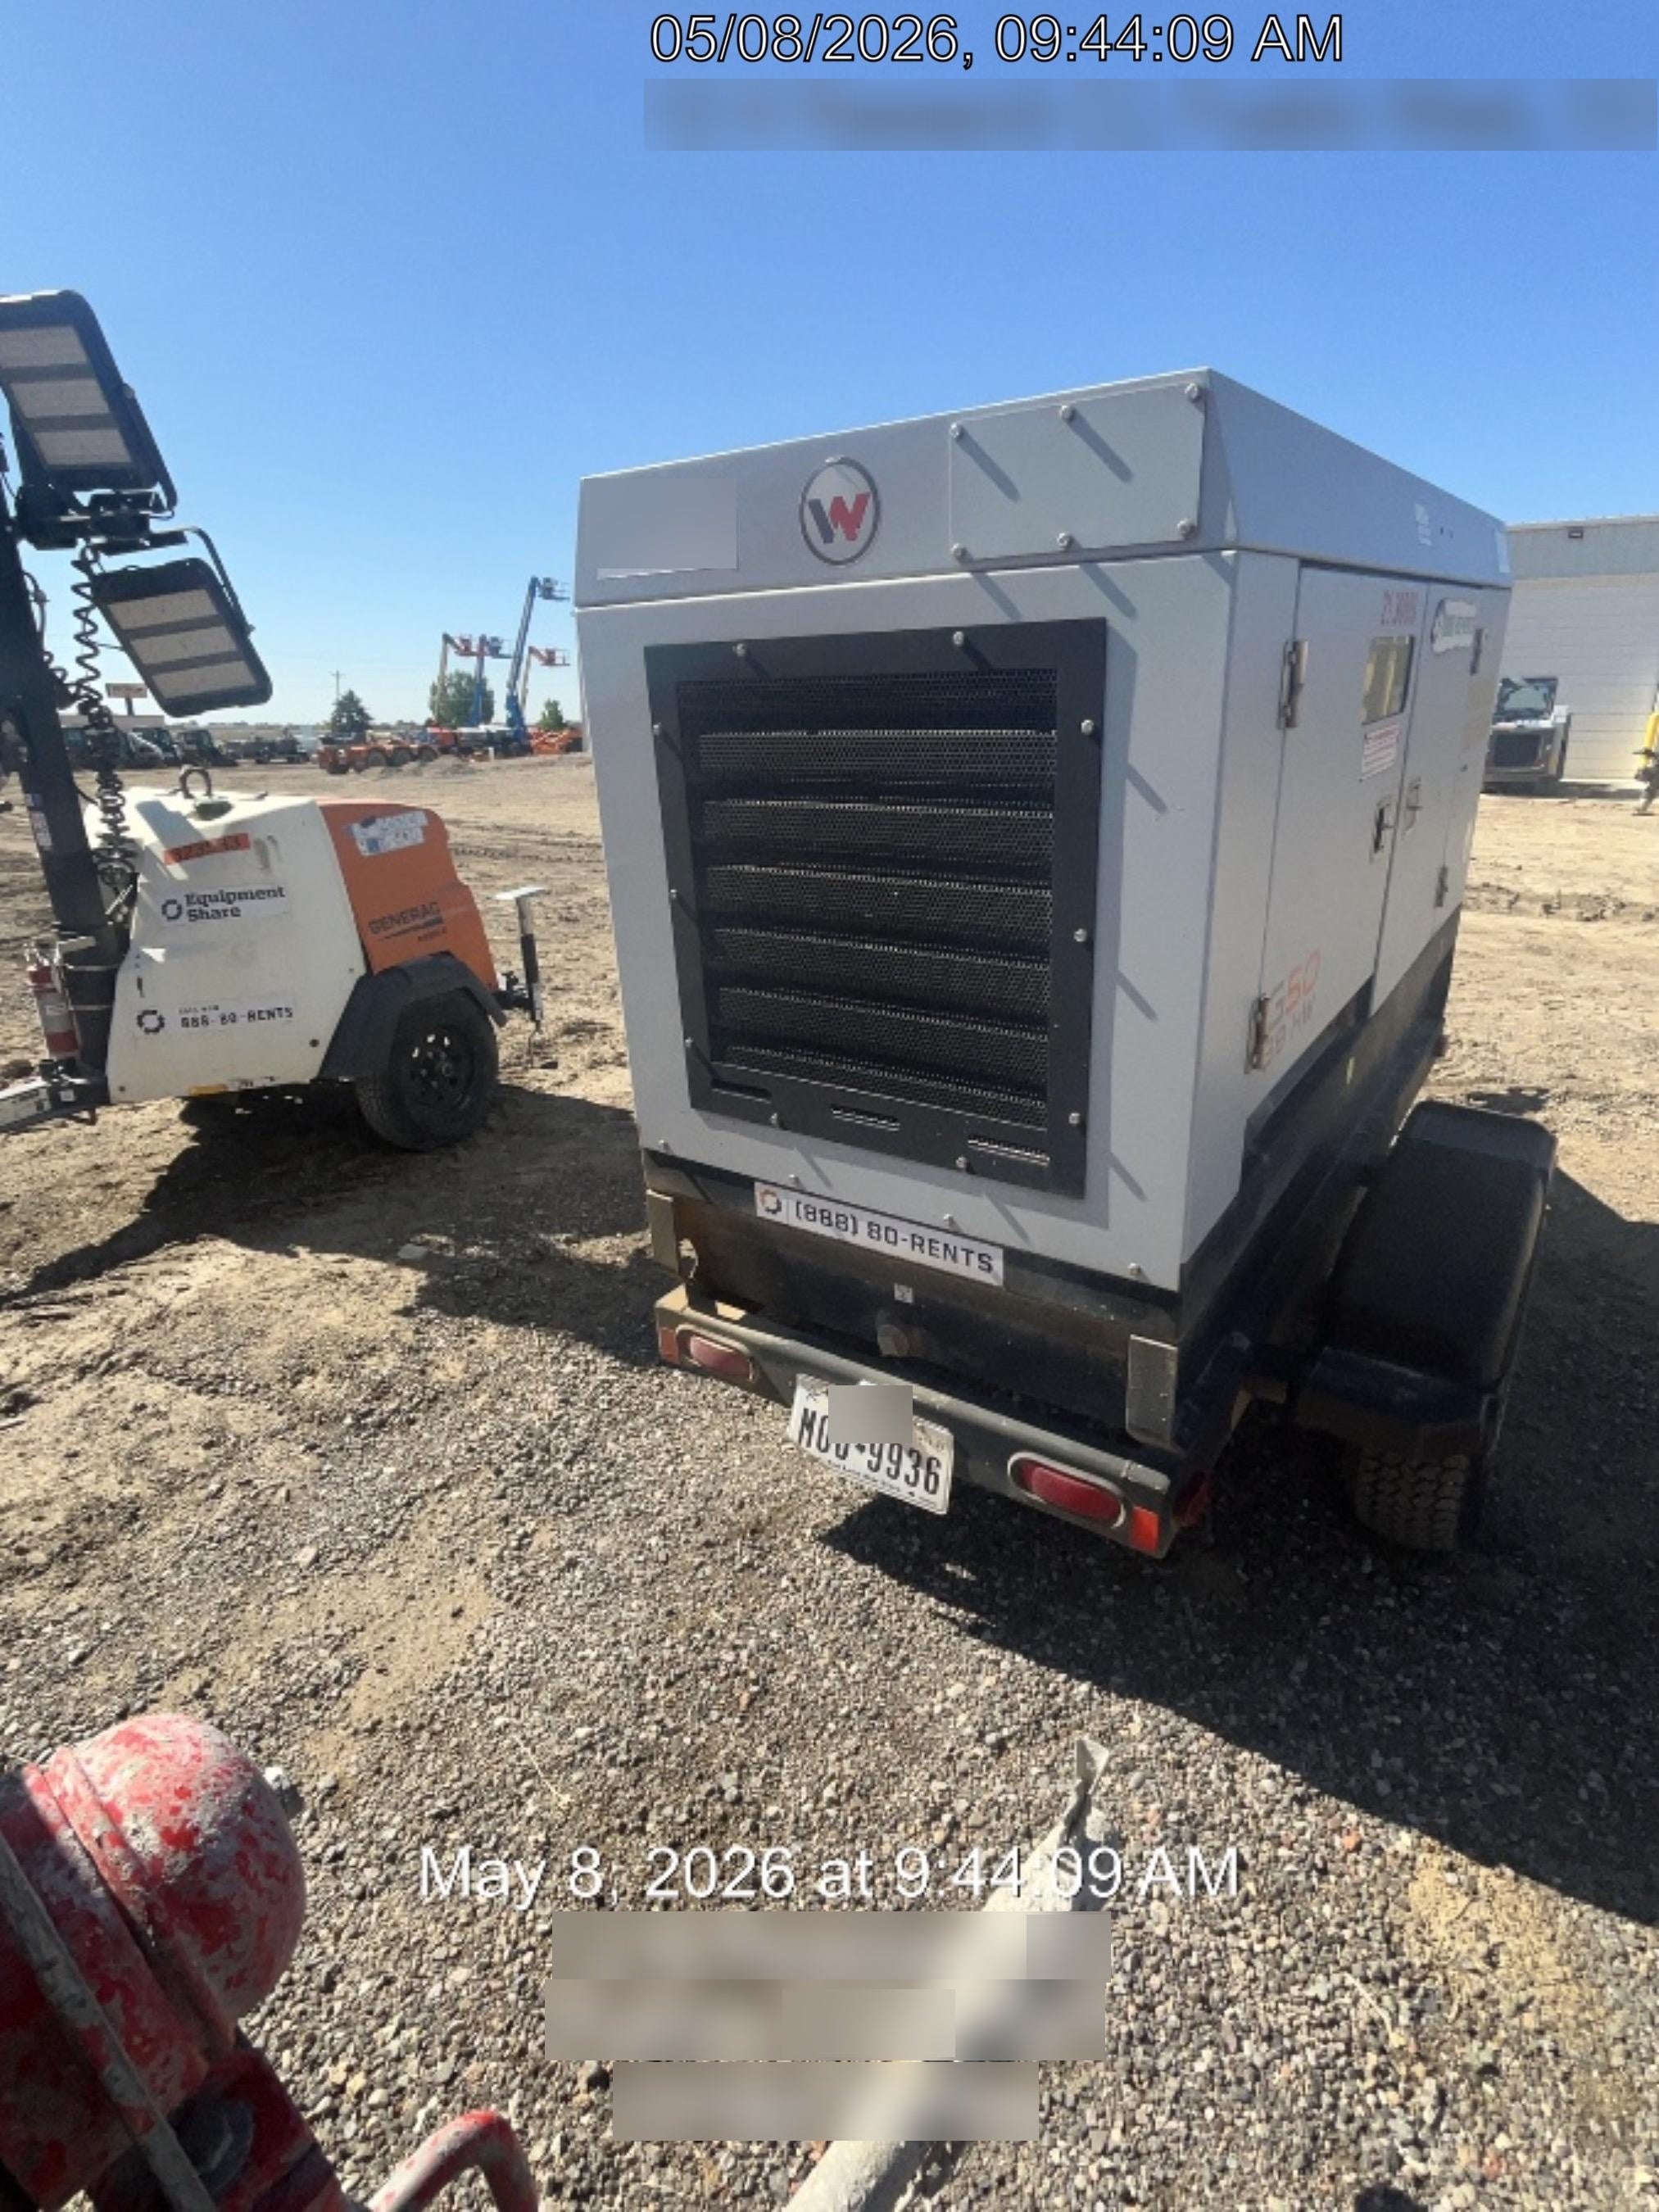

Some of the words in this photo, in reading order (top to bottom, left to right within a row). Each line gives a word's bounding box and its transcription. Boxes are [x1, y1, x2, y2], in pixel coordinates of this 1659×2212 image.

[184, 886, 286, 906] Equipment
[187, 906, 242, 922] Share
[369, 901, 441, 935] GENERAC
[796, 1200, 859, 1236] (888)
[867, 1221, 994, 1274] 80-RENTS
